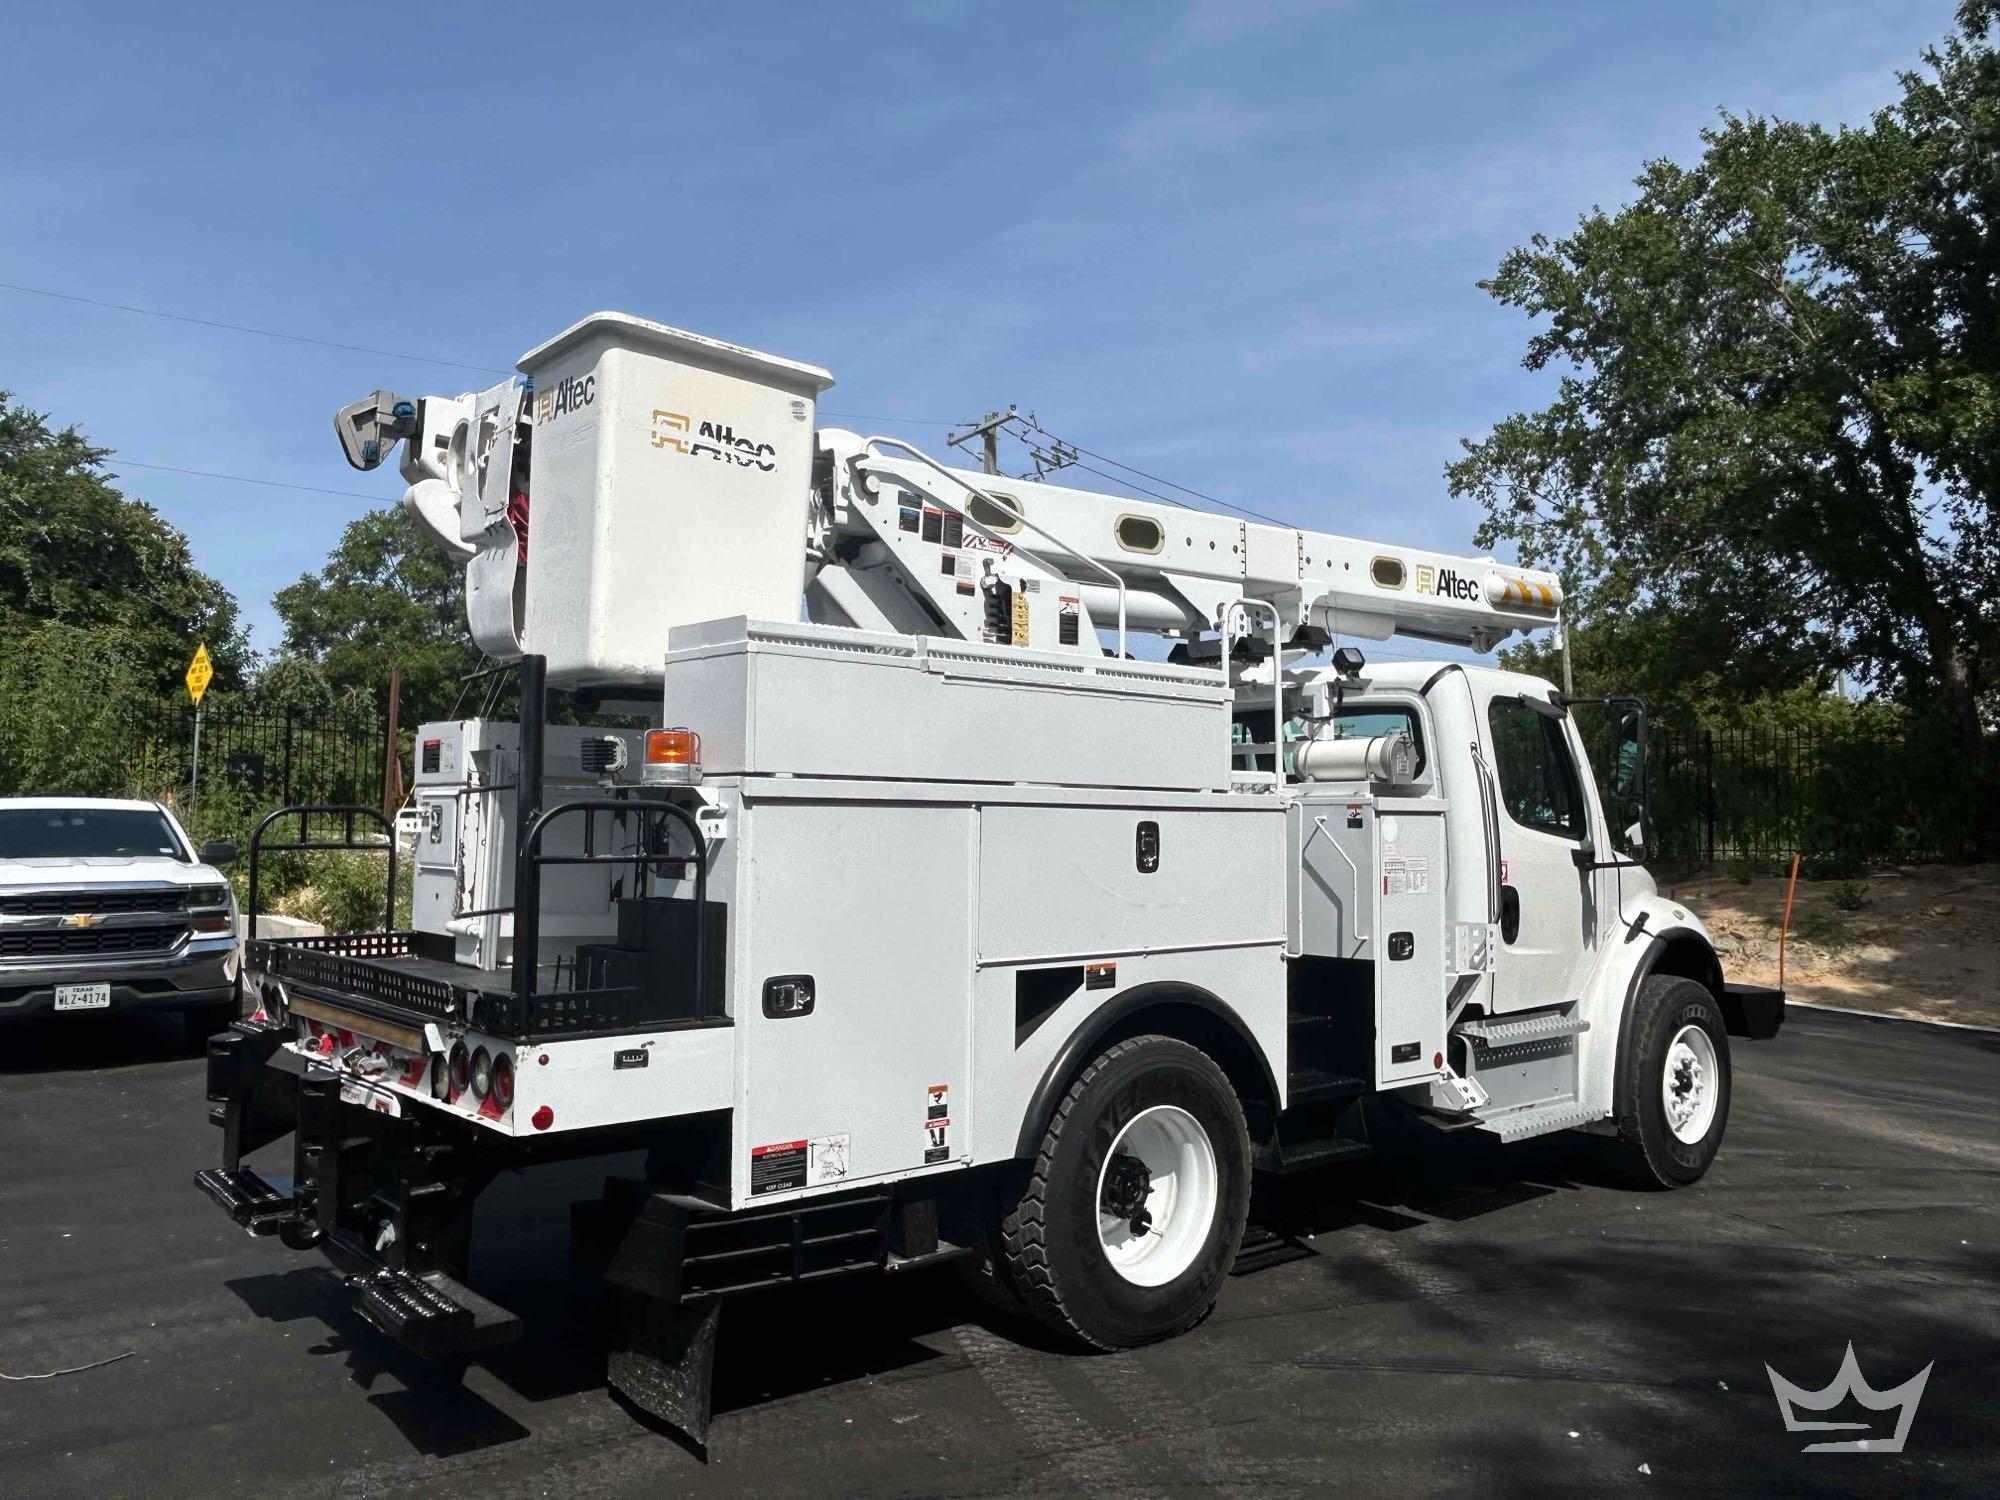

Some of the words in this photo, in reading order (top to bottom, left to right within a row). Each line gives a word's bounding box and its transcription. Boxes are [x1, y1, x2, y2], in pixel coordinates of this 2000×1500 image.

[554, 376, 595, 420] Altec
[690, 421, 776, 471] Altec
[1437, 569, 1479, 601] Altec
